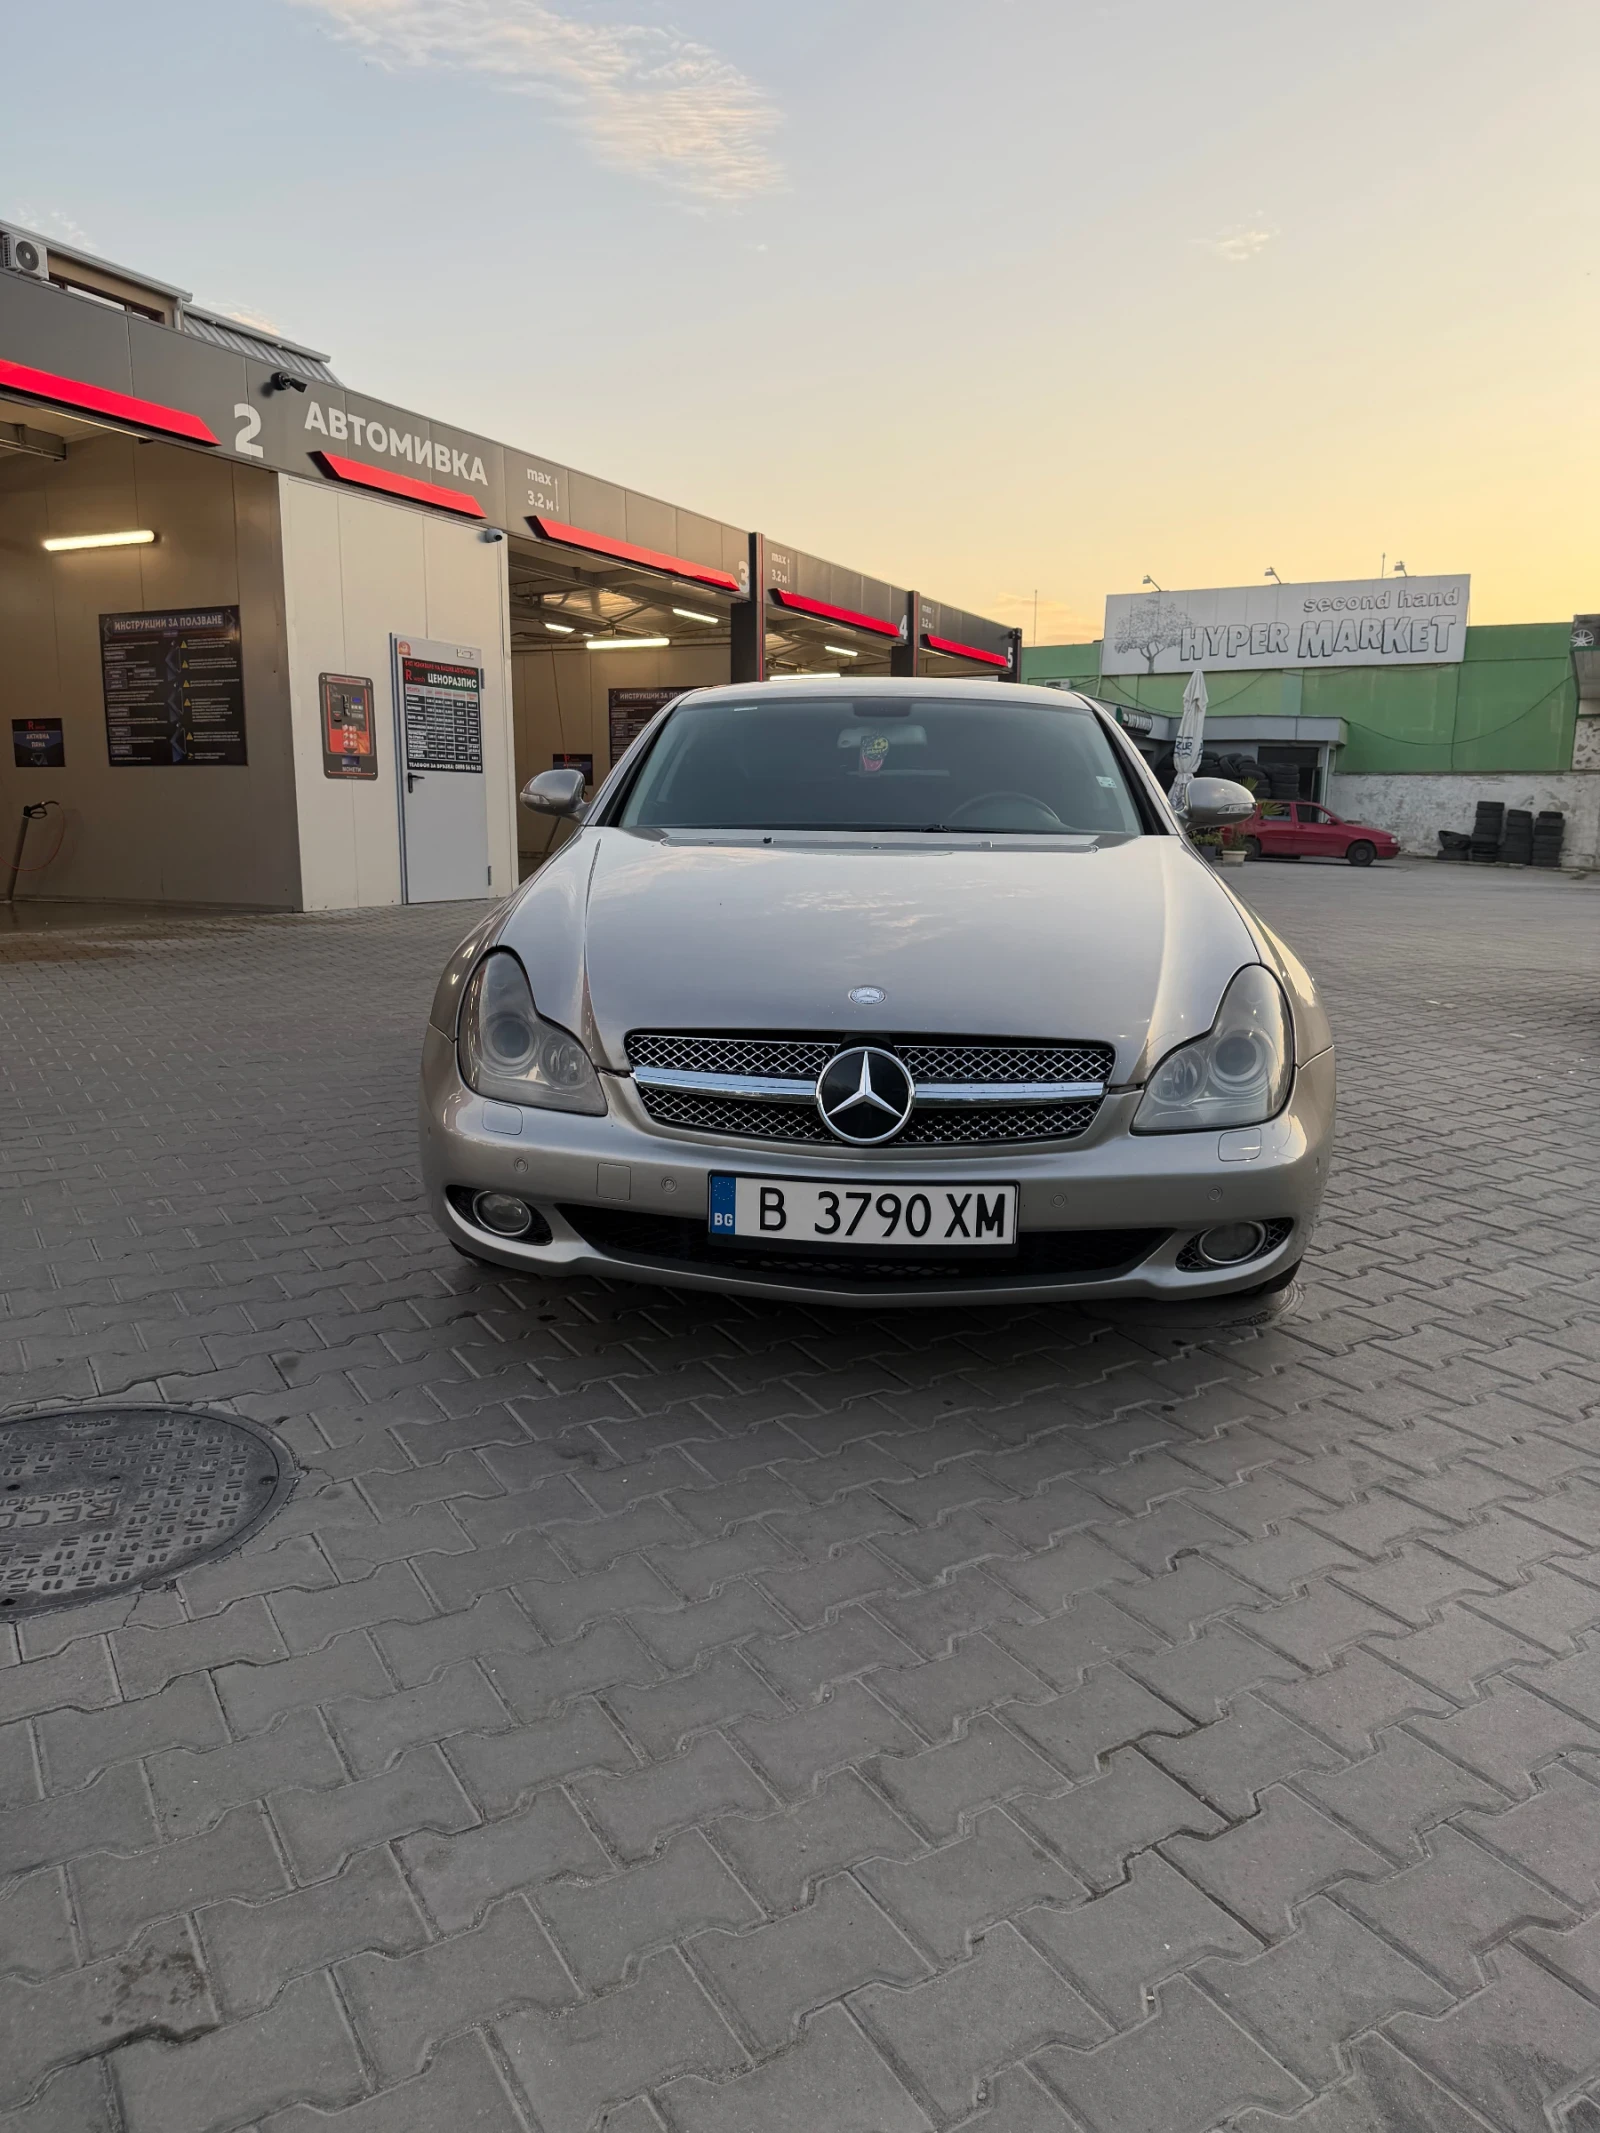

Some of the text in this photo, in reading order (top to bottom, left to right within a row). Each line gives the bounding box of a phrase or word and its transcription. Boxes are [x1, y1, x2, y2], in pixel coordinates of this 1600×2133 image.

[233, 402, 265, 459] 2
[304, 401, 489, 486] АВТОМИВКА
[526, 468, 552, 486] max
[527, 490, 545, 509] 3.2
[771, 551, 787, 565] max
[738, 560, 749, 594] 3
[1302, 587, 1460, 613] second hand
[114, 614, 223, 631] ИНСТРУКЦИИ ЗА ПОЛЗВАНЕ
[899, 614, 908, 640] 4
[1179, 615, 1457, 662] HYPER MARKET
[1006, 646, 1015, 669] 5
[427, 672, 478, 689] ЦЕНОРАЗПИС
[714, 1212, 733, 1227] BG
[759, 1186, 1006, 1238] B 3790 XM
